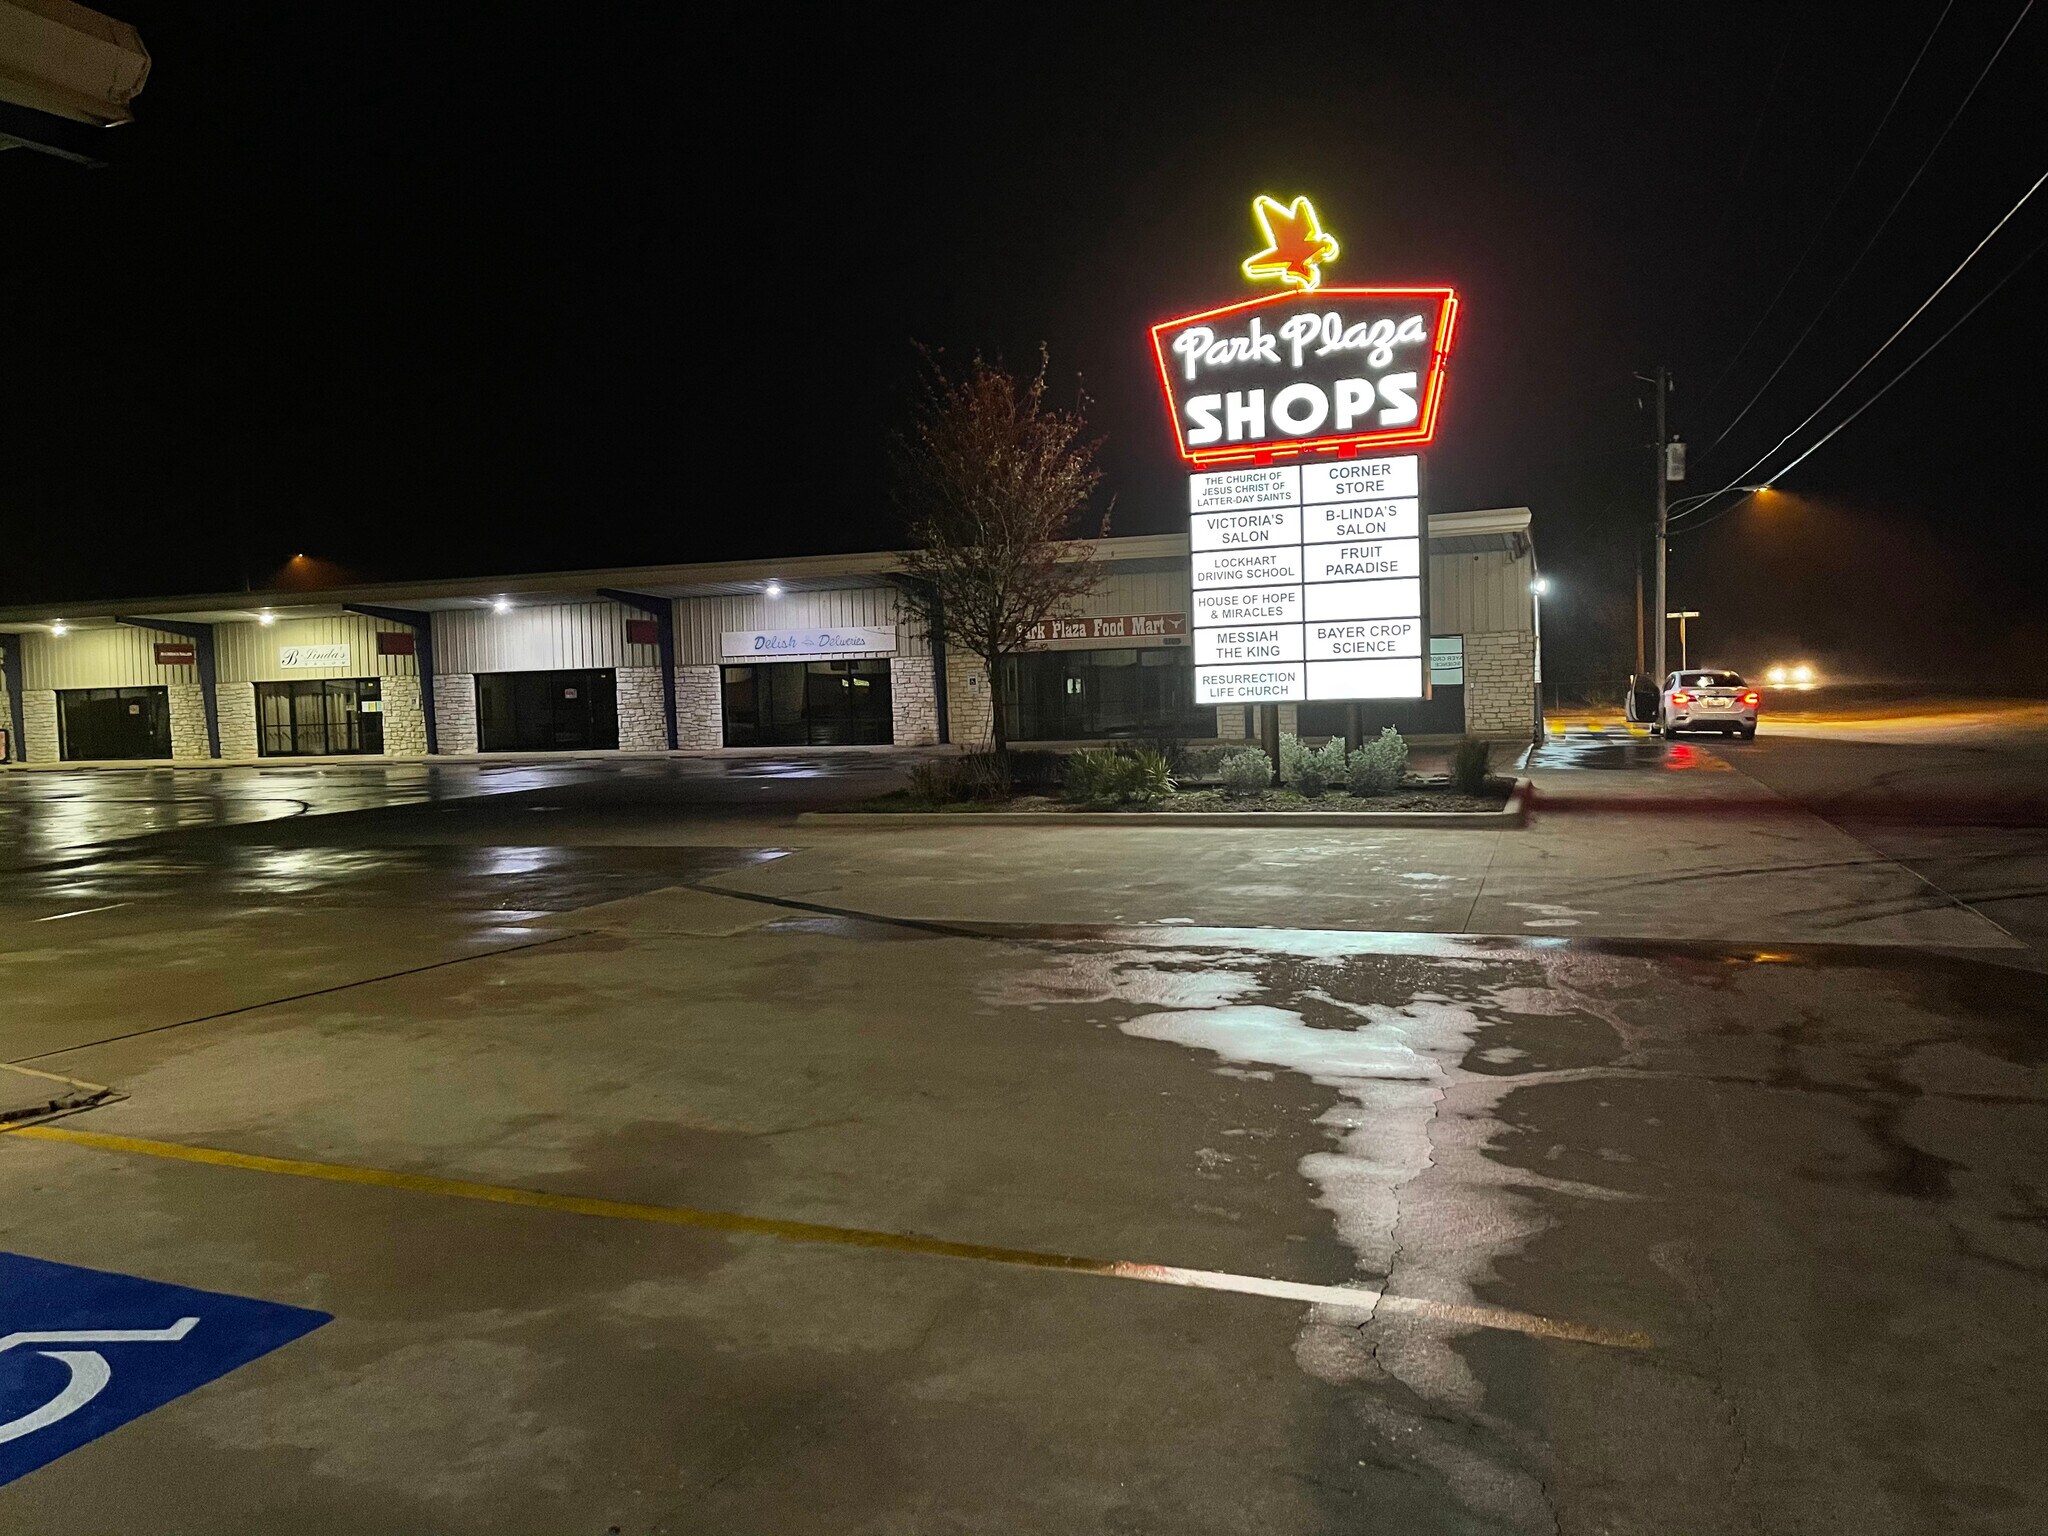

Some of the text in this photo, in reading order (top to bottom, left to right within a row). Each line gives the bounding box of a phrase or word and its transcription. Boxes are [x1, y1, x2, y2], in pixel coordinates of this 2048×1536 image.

[1172, 311, 1428, 379] Park Plaza
[1184, 371, 1418, 445] SHOPS
[1205, 471, 1282, 486] THE CHURCH OF
[1329, 463, 1391, 480] CORNER
[1202, 481, 1285, 496] JESUS CHRIST OF
[1335, 480, 1385, 495] STORE
[1197, 491, 1292, 507] LATTER-DAY SAINTS
[1326, 505, 1397, 522] B-LINDA'S
[1206, 513, 1284, 530] VICTORIA'S
[1336, 522, 1386, 536] SALON
[1222, 530, 1269, 544] SALON
[1340, 546, 1383, 560] FRUIT
[1214, 555, 1277, 568] LOCKHART
[1326, 561, 1399, 576] PARADISE
[1197, 567, 1295, 582] DRIVING SCHOOL
[1198, 592, 1296, 607] HOUSE OF HOPE
[1210, 606, 1283, 619] & MIRACLES
[1052, 620, 1087, 639] Plaza
[1093, 618, 1125, 637] Food
[1131, 616, 1165, 636] Mart
[1317, 624, 1412, 639] BAYER CROP
[754, 635, 798, 650] Delish
[1217, 630, 1279, 644] MESSIAH
[1216, 645, 1281, 659] THE KING
[1332, 640, 1396, 654] SCIENCE
[1202, 672, 1296, 685] RESURRECTION
[1209, 685, 1289, 698] LIFE CHURCH
